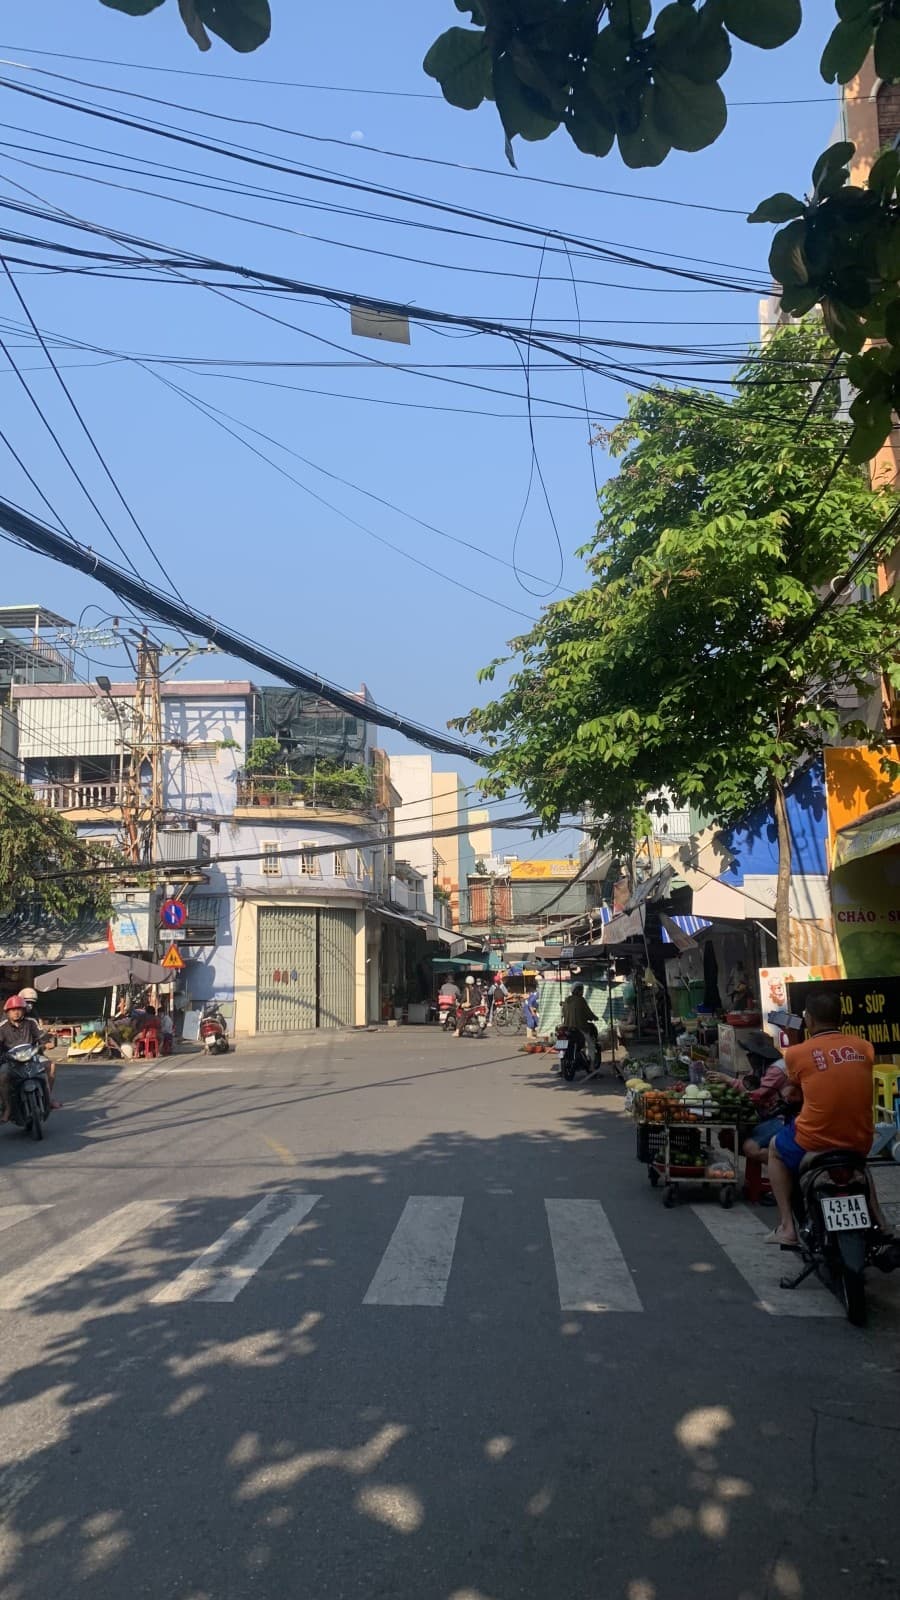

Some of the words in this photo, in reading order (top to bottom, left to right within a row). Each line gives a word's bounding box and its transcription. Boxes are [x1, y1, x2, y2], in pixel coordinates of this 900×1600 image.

[865, 990, 885, 1014] SÚP
[829, 1199, 861, 1214] 43-AA
[827, 1212, 868, 1229] 145.16
